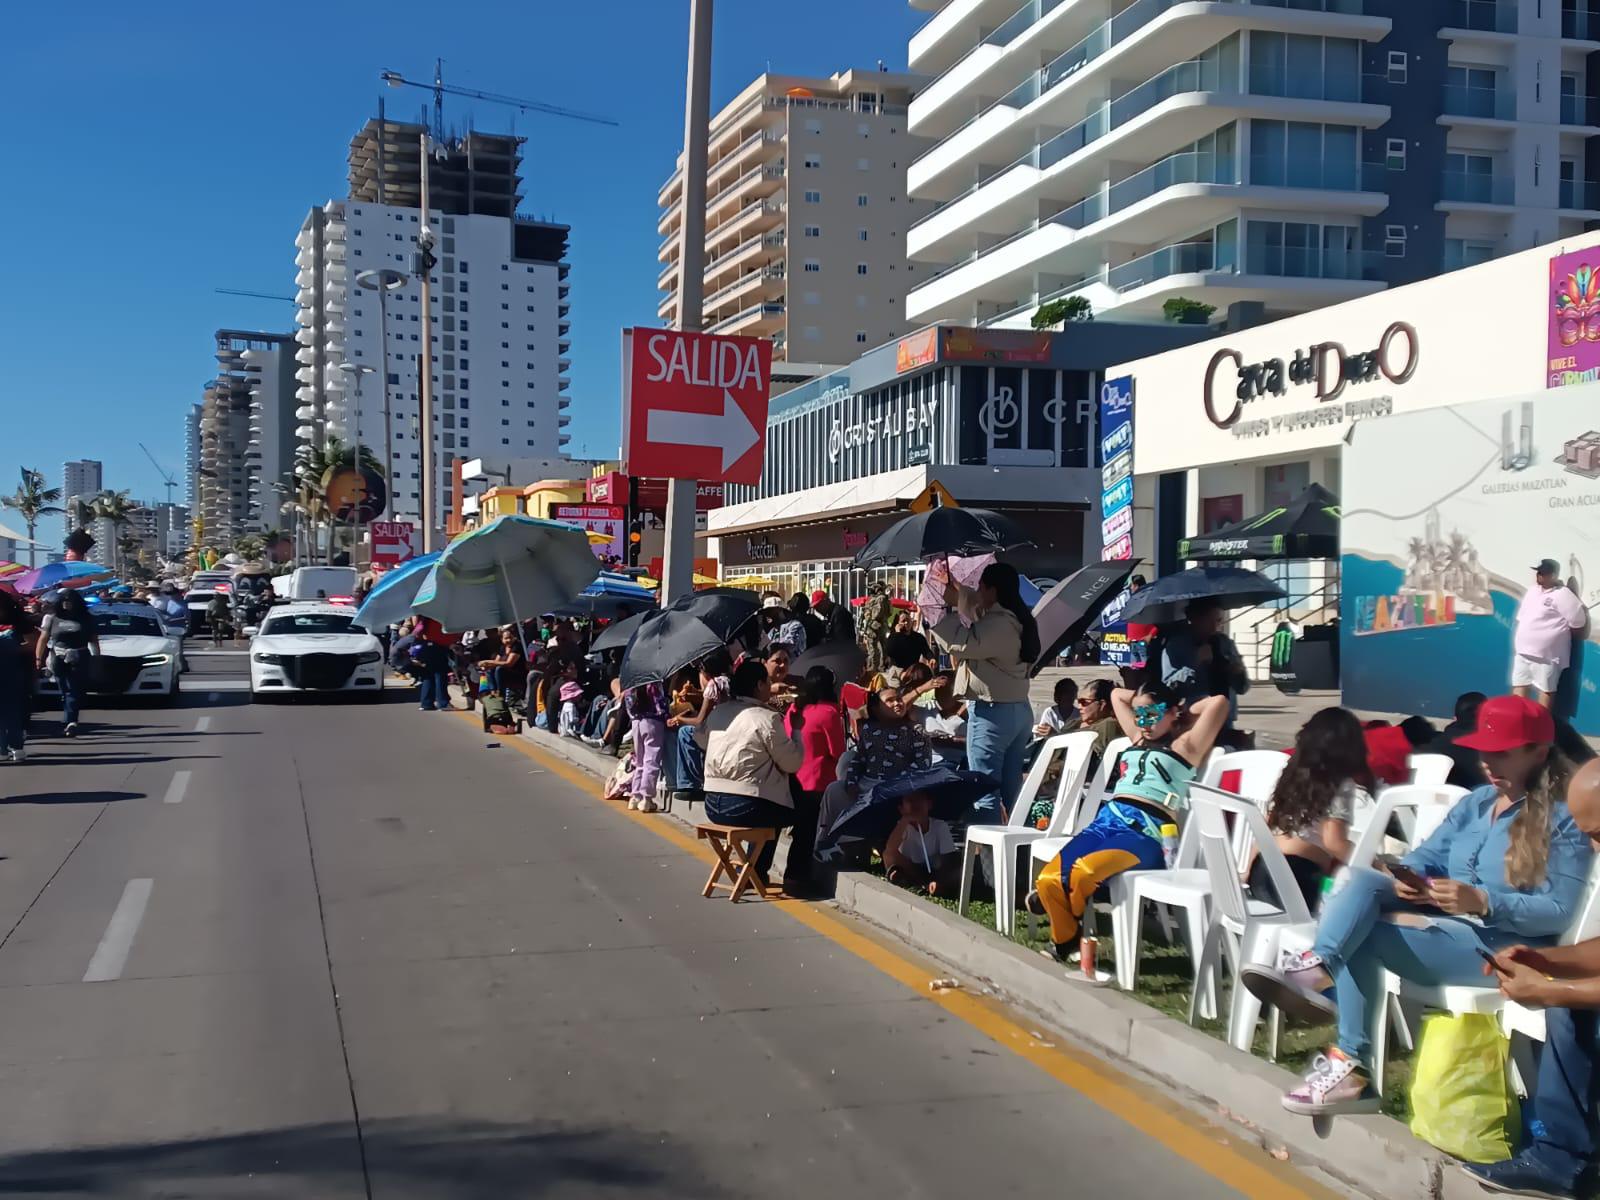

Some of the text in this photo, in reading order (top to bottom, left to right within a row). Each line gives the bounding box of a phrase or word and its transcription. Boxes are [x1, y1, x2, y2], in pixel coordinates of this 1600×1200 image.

[647, 334, 763, 391] SALIDA
[1204, 348, 1288, 430] Cava
[845, 400, 938, 448] CRISTAL BAY
[696, 486, 722, 497] AFFE
[374, 523, 411, 537] SALIDA
[1209, 539, 1249, 551] MONSTER
[1081, 575, 1112, 600] NICE
